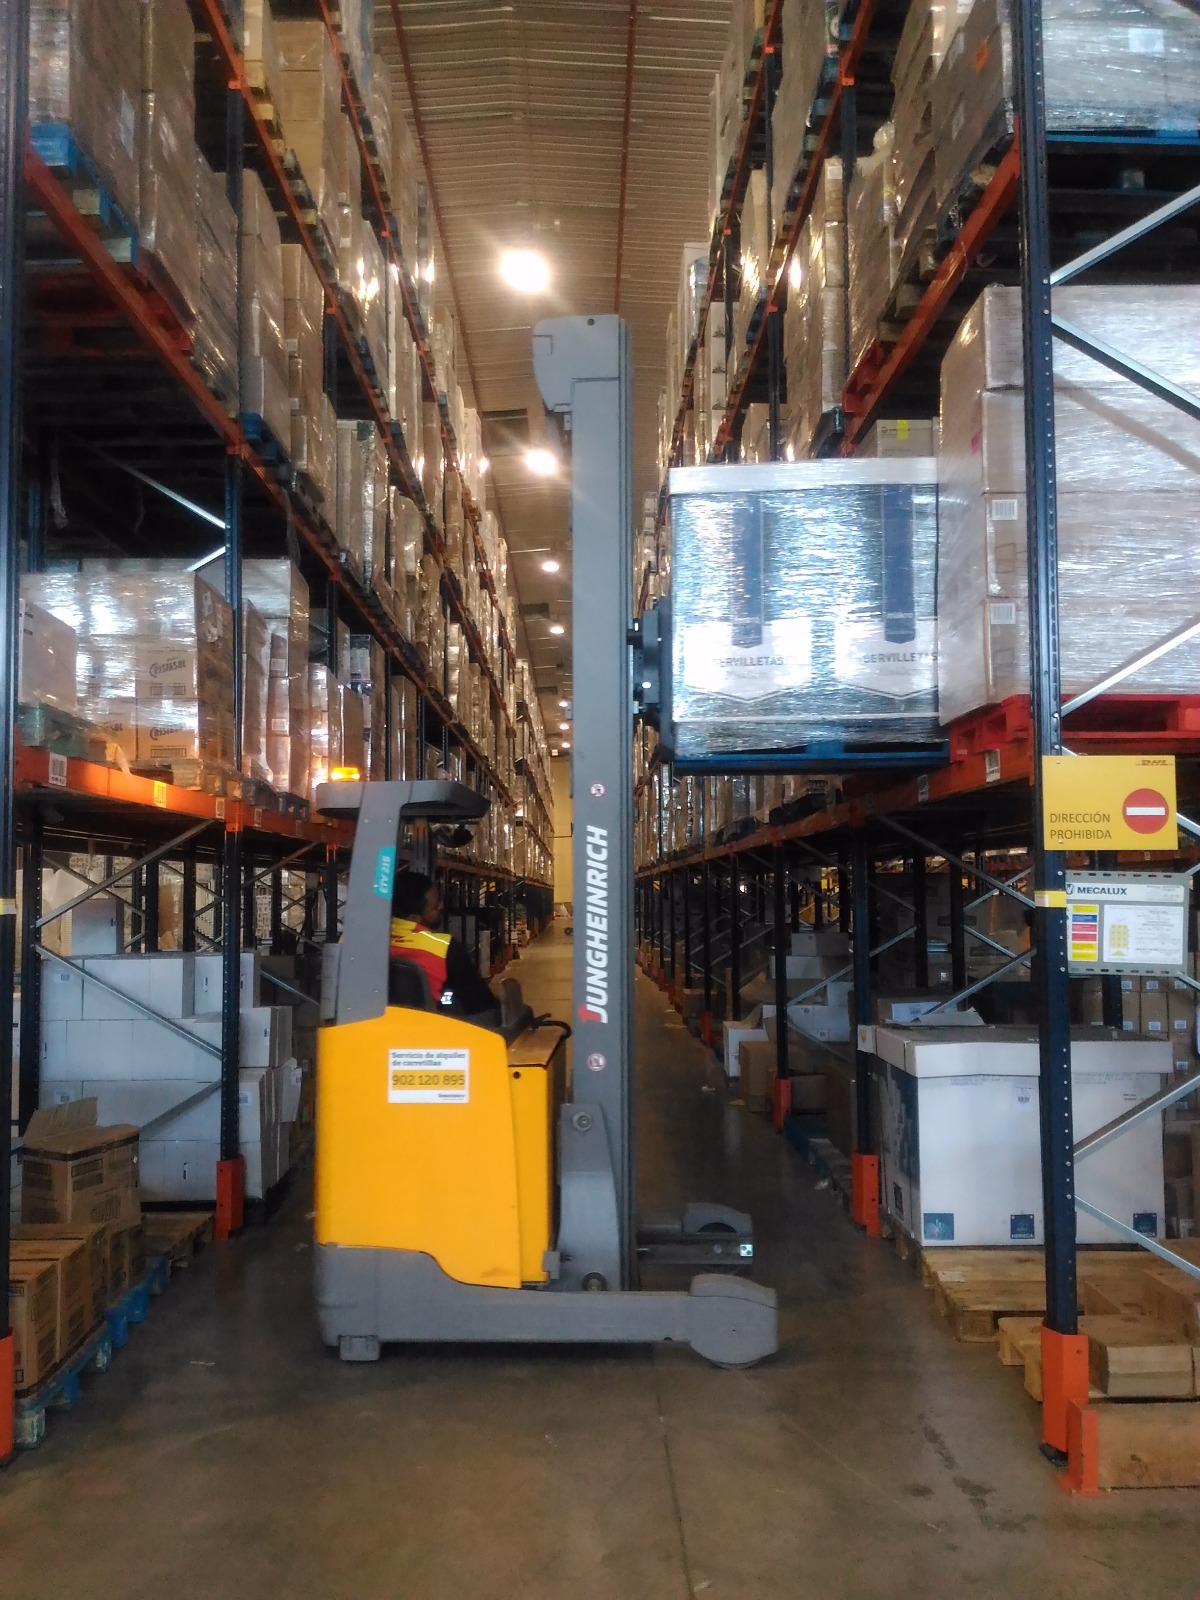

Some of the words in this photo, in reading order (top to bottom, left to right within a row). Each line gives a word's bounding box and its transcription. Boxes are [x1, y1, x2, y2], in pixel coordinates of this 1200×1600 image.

[714, 656, 784, 668] ERVILLETAS
[1050, 811, 1111, 824] DIRECCIÓN
[1050, 829, 1112, 840] PROHIBIDA
[1077, 886, 1128, 896] MECALUX
[585, 825, 609, 1024] JUNGHEINRICH
[436, 1052, 466, 1060] alquiler
[392, 1074, 415, 1086] 902
[418, 1074, 440, 1086] 120
[442, 1074, 465, 1086] 895
